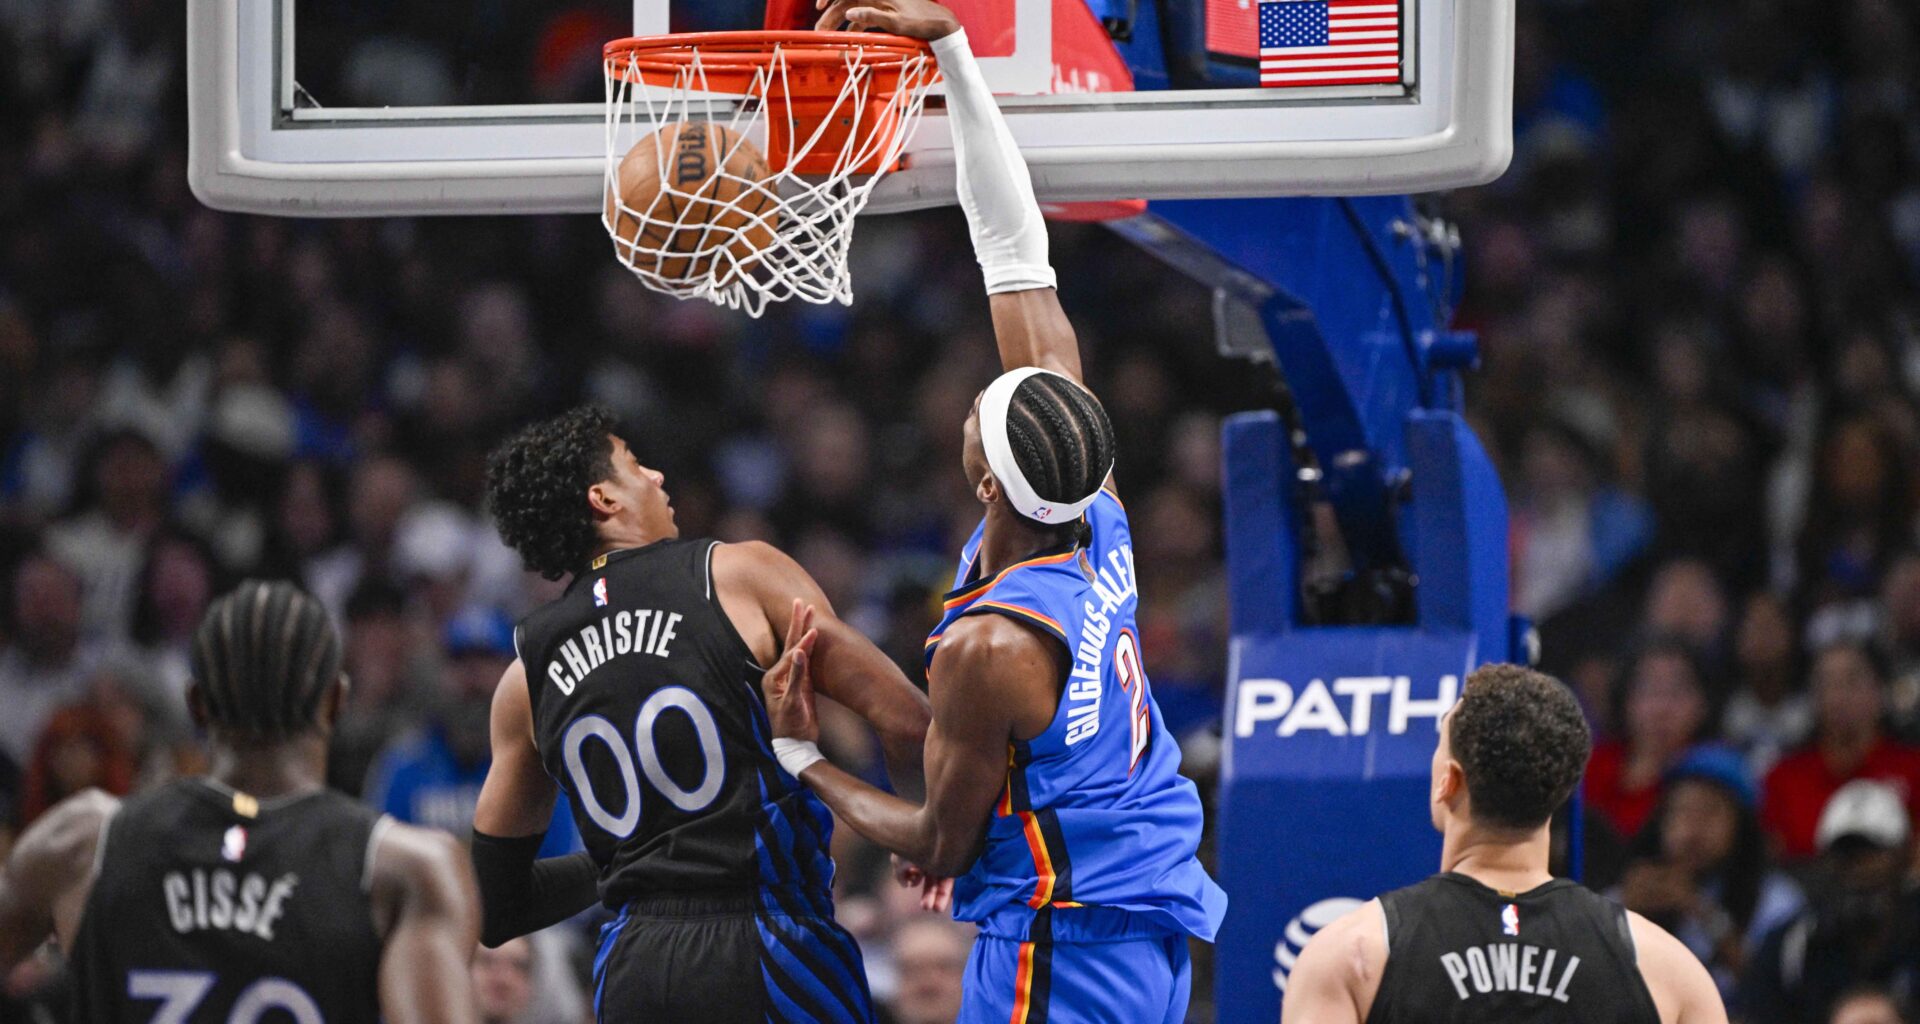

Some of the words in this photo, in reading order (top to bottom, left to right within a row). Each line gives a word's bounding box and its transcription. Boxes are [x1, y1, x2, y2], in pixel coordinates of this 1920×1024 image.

[547, 609, 683, 697] CHRISTIE
[1114, 627, 1151, 779] 2
[1234, 674, 1459, 739] PATH
[561, 684, 726, 841] 00
[162, 868, 299, 942] CISSÉ
[1440, 942, 1581, 1003] POWELL
